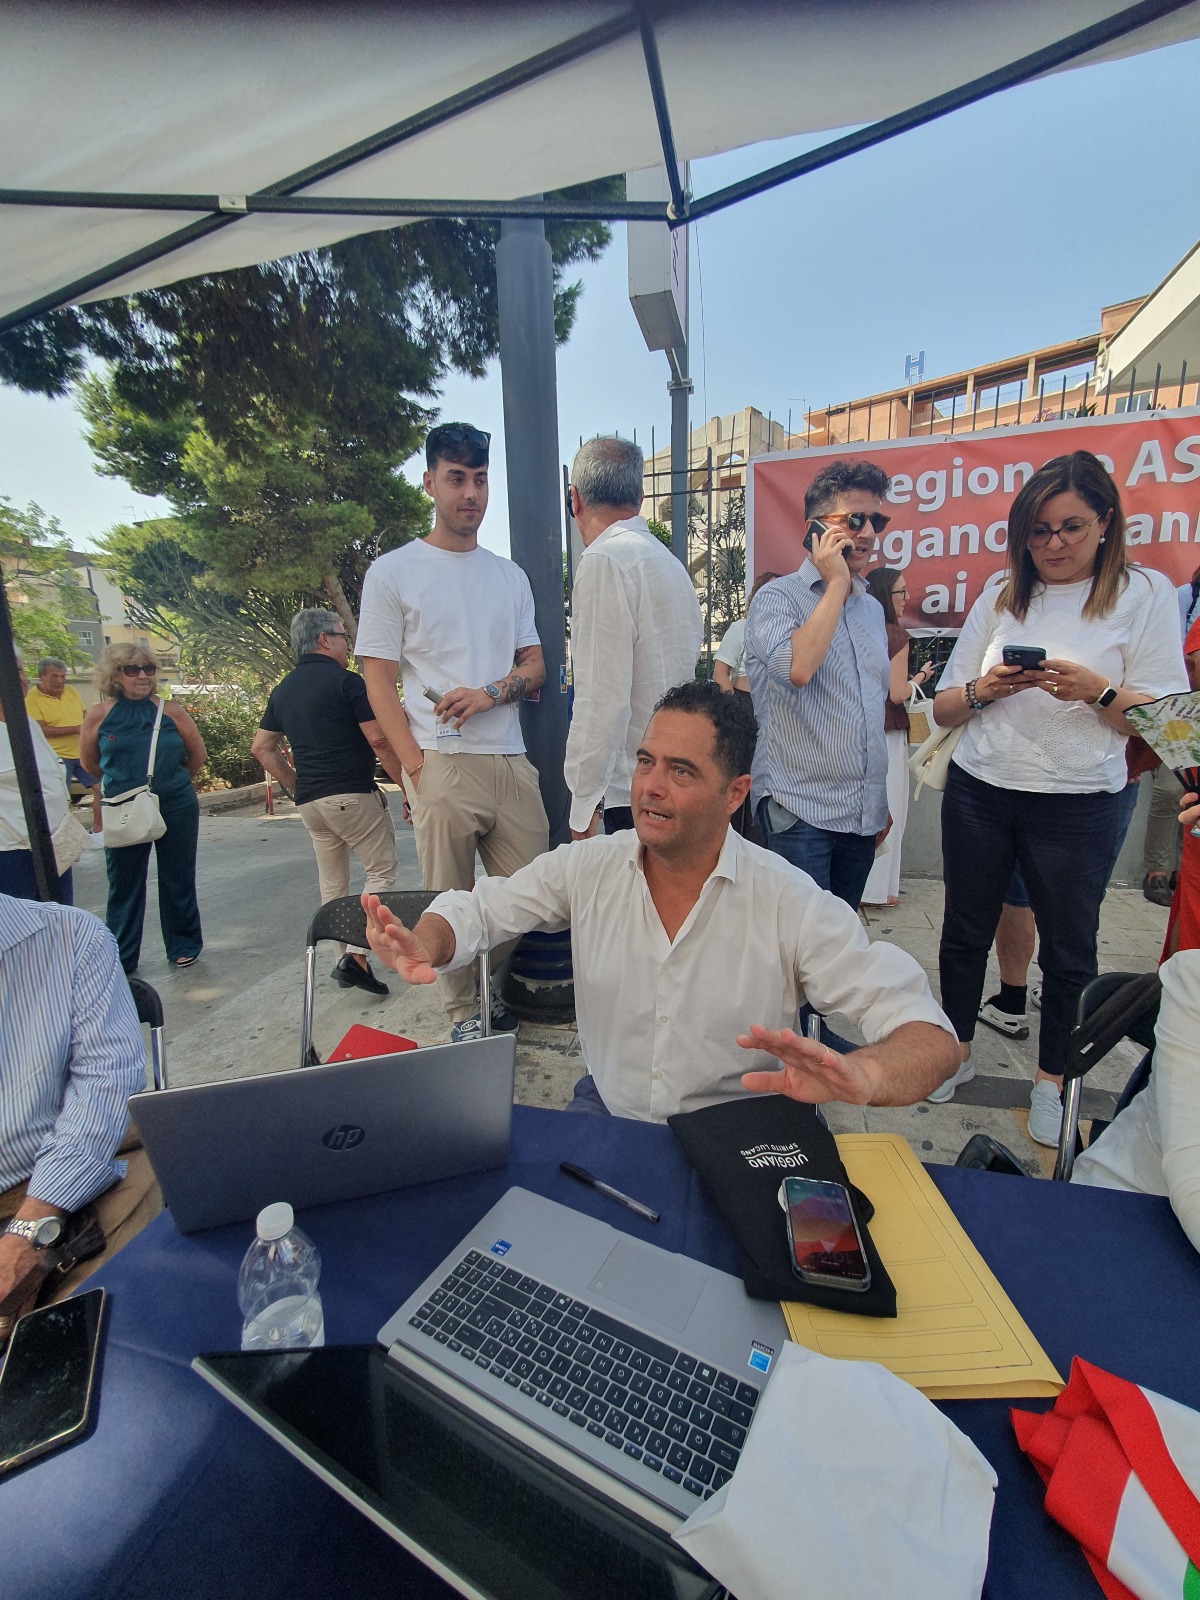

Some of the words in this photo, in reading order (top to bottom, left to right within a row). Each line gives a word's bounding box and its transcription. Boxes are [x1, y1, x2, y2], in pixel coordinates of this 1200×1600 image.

[905, 350, 925, 380] H
[880, 457, 1057, 512] egion
[921, 571, 967, 614] ai
[740, 1144, 770, 1156] LUCANO
[770, 1142, 798, 1151] SPIRITO
